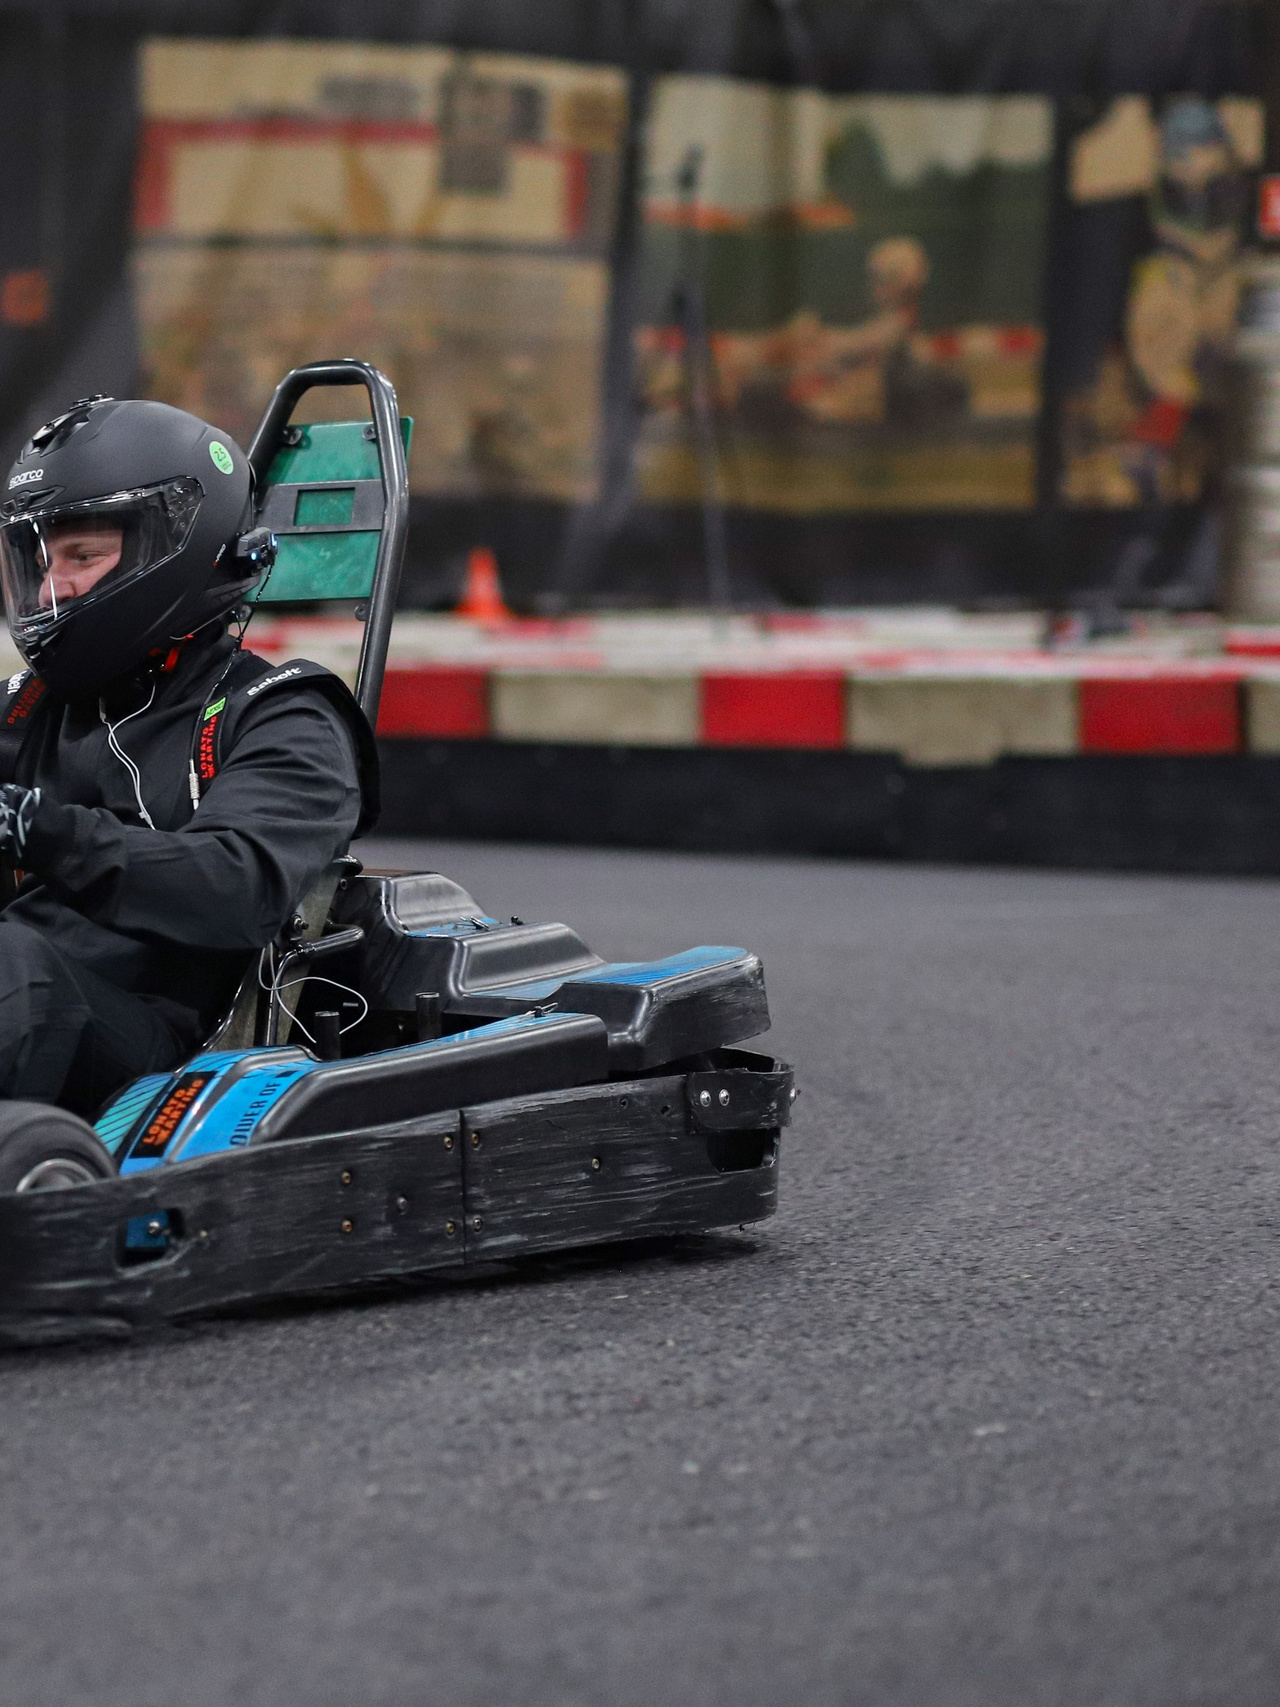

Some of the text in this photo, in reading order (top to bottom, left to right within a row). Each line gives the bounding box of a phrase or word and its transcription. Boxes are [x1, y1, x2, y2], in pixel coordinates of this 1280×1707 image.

[8, 469, 44, 490] sparco
[246, 667, 302, 696] Sabelt
[200, 727, 209, 778] LONATO
[142, 1087, 188, 1144] LONATO
[153, 1079, 205, 1146] KARTING
[229, 1082, 282, 1146] OWER OF
